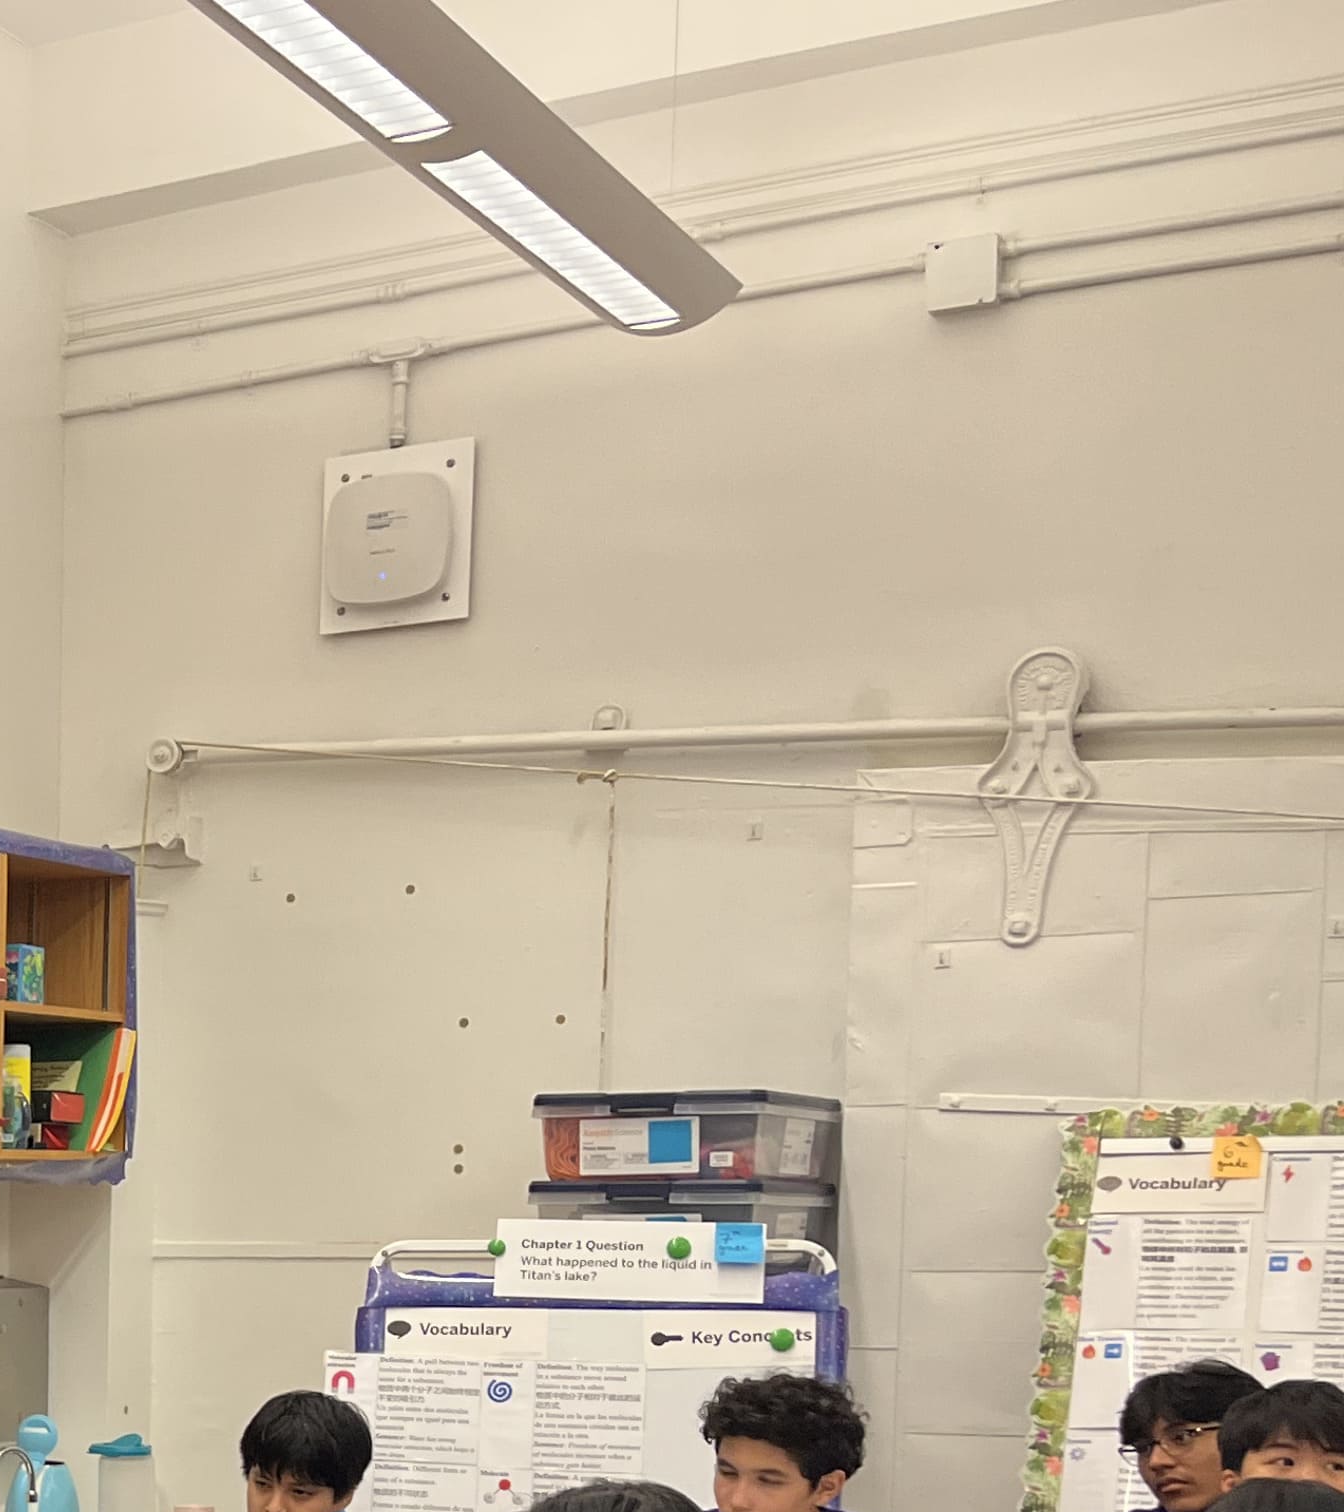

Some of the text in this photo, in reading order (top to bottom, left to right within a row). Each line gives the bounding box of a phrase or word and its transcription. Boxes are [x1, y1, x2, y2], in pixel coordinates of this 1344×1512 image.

[1128, 1177, 1227, 1193] Vocabulary
[521, 1238, 644, 1252] Chapter 1 Question
[520, 1255, 712, 1271] What happened to the liquid in
[520, 1269, 598, 1282] Titan's lake?
[419, 1322, 513, 1339] Vocabulary
[691, 1327, 814, 1347] Key Concts
